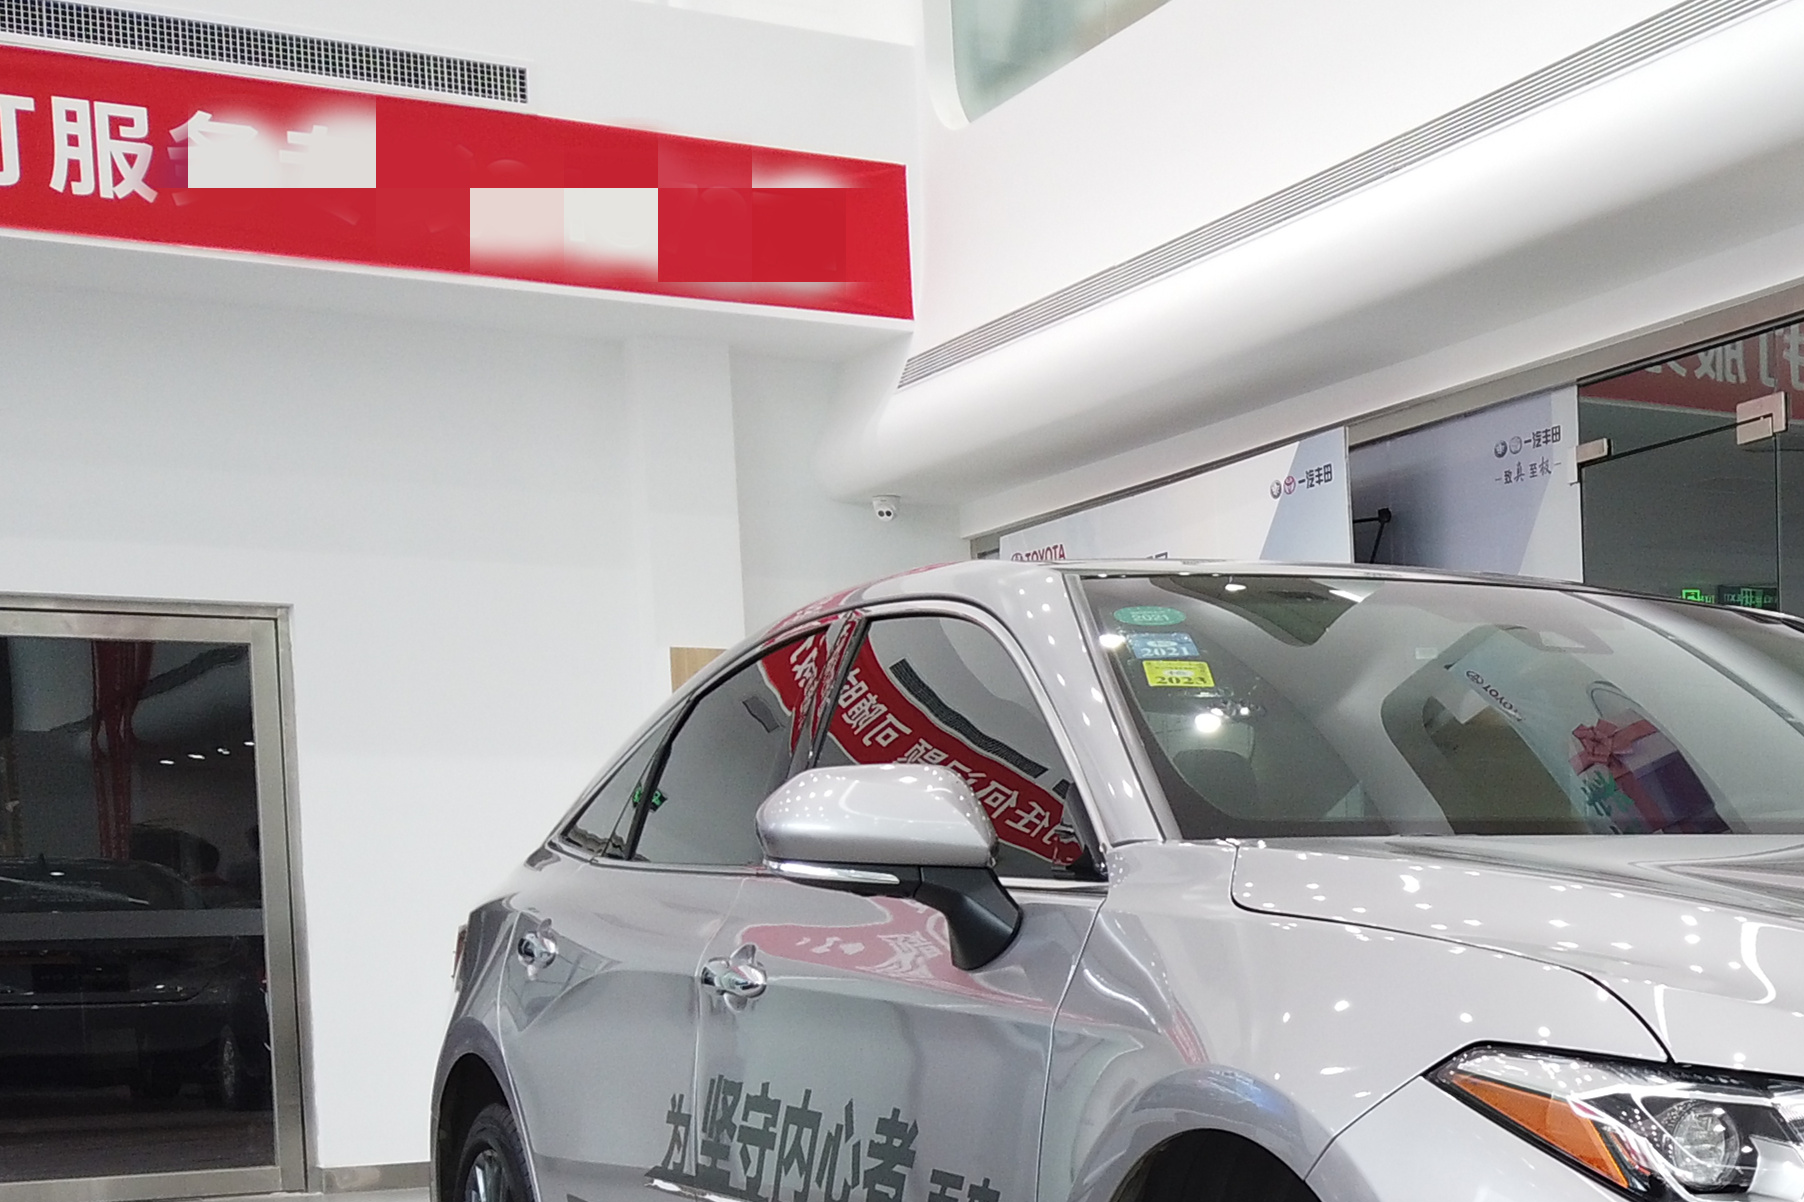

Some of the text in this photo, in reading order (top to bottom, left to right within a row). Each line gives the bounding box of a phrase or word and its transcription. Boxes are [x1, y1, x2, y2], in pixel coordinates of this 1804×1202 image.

[1523, 425, 1561, 450] 一汽丰田
[1298, 463, 1333, 490] 一汽丰田
[1140, 647, 1191, 657] 2021
[1155, 676, 1208, 686] 2023
